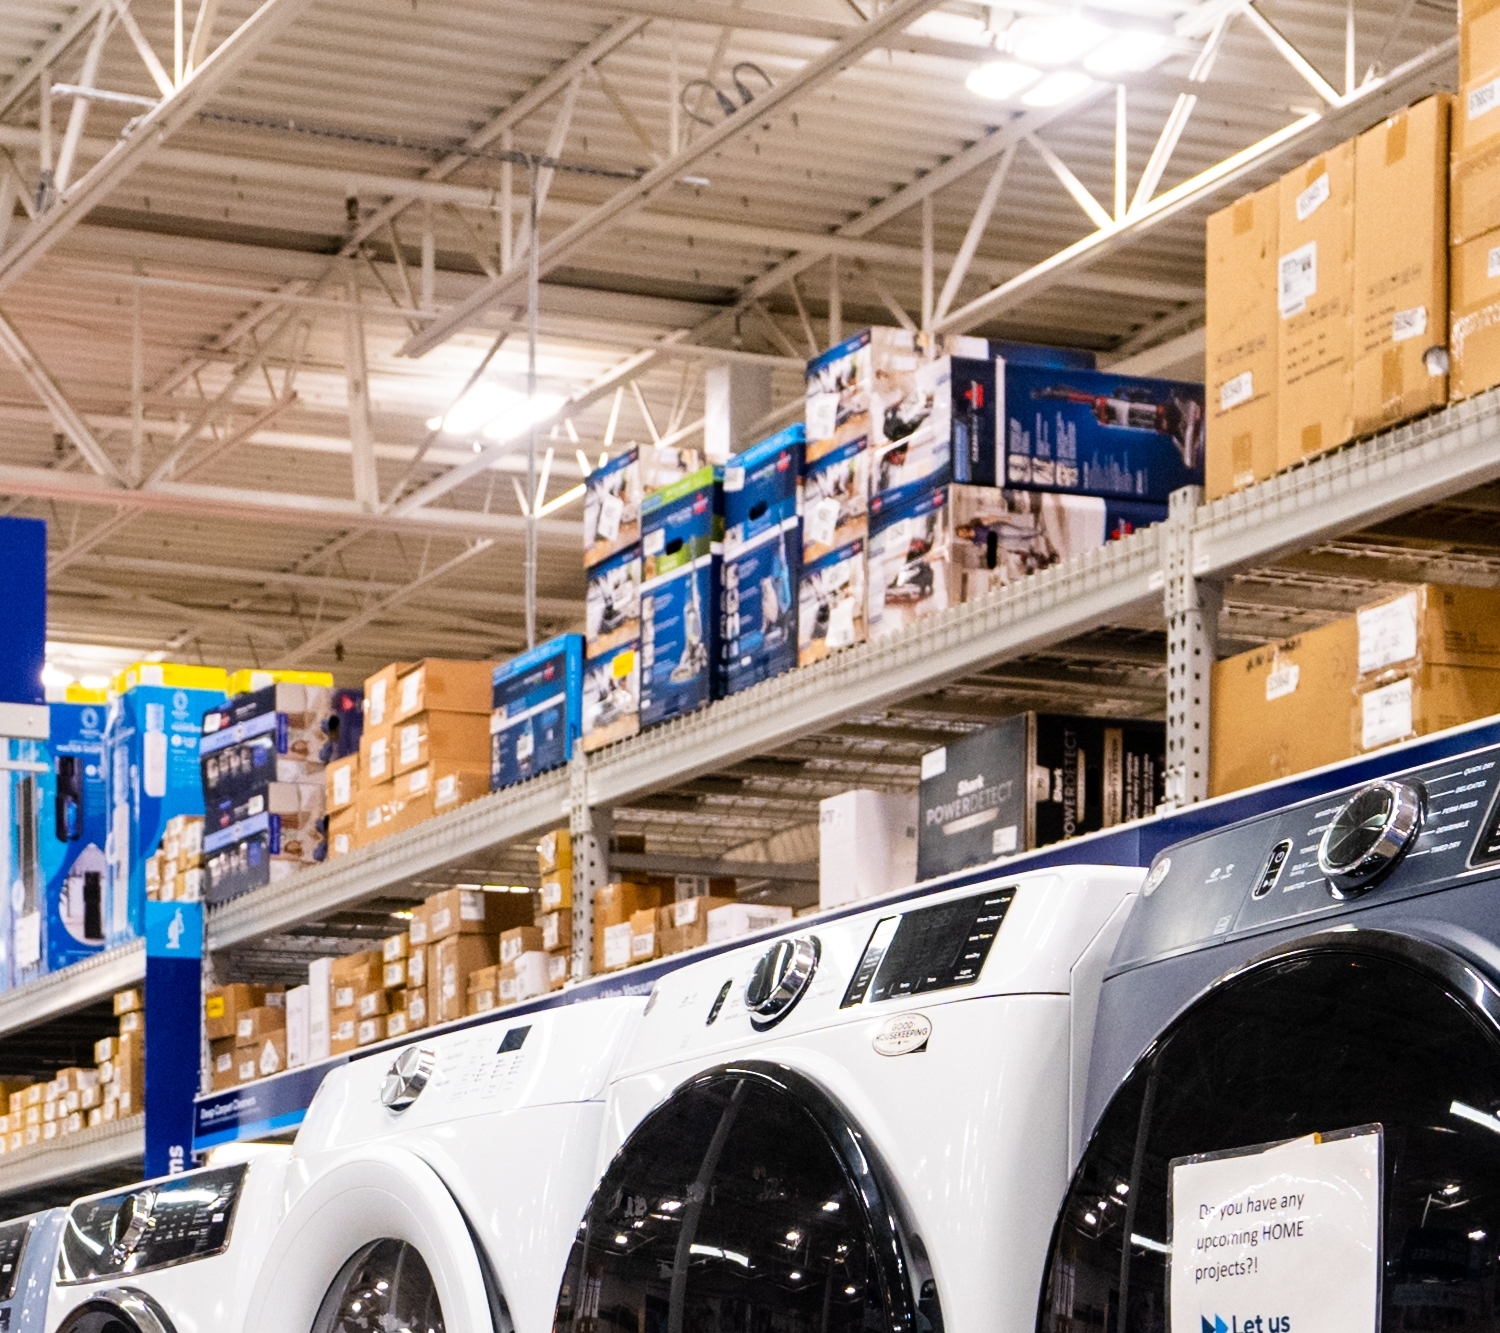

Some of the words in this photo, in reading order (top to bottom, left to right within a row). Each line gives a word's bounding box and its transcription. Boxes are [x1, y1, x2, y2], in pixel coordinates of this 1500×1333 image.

[957, 774, 984, 797] Shark
[1053, 767, 1063, 803] Shark
[926, 779, 1014, 827] POWERDETECT
[876, 1028, 928, 1041] HOUSEKEEPING
[892, 1021, 913, 1031] GOOD
[1199, 1203, 1216, 1220] Do
[1219, 1201, 1244, 1223] you
[1246, 1195, 1277, 1213] have
[1280, 1192, 1305, 1216] any
[1196, 1228, 1258, 1252] upcoming
[1262, 1220, 1305, 1241] HOME
[1195, 1257, 1258, 1284] projects?!
